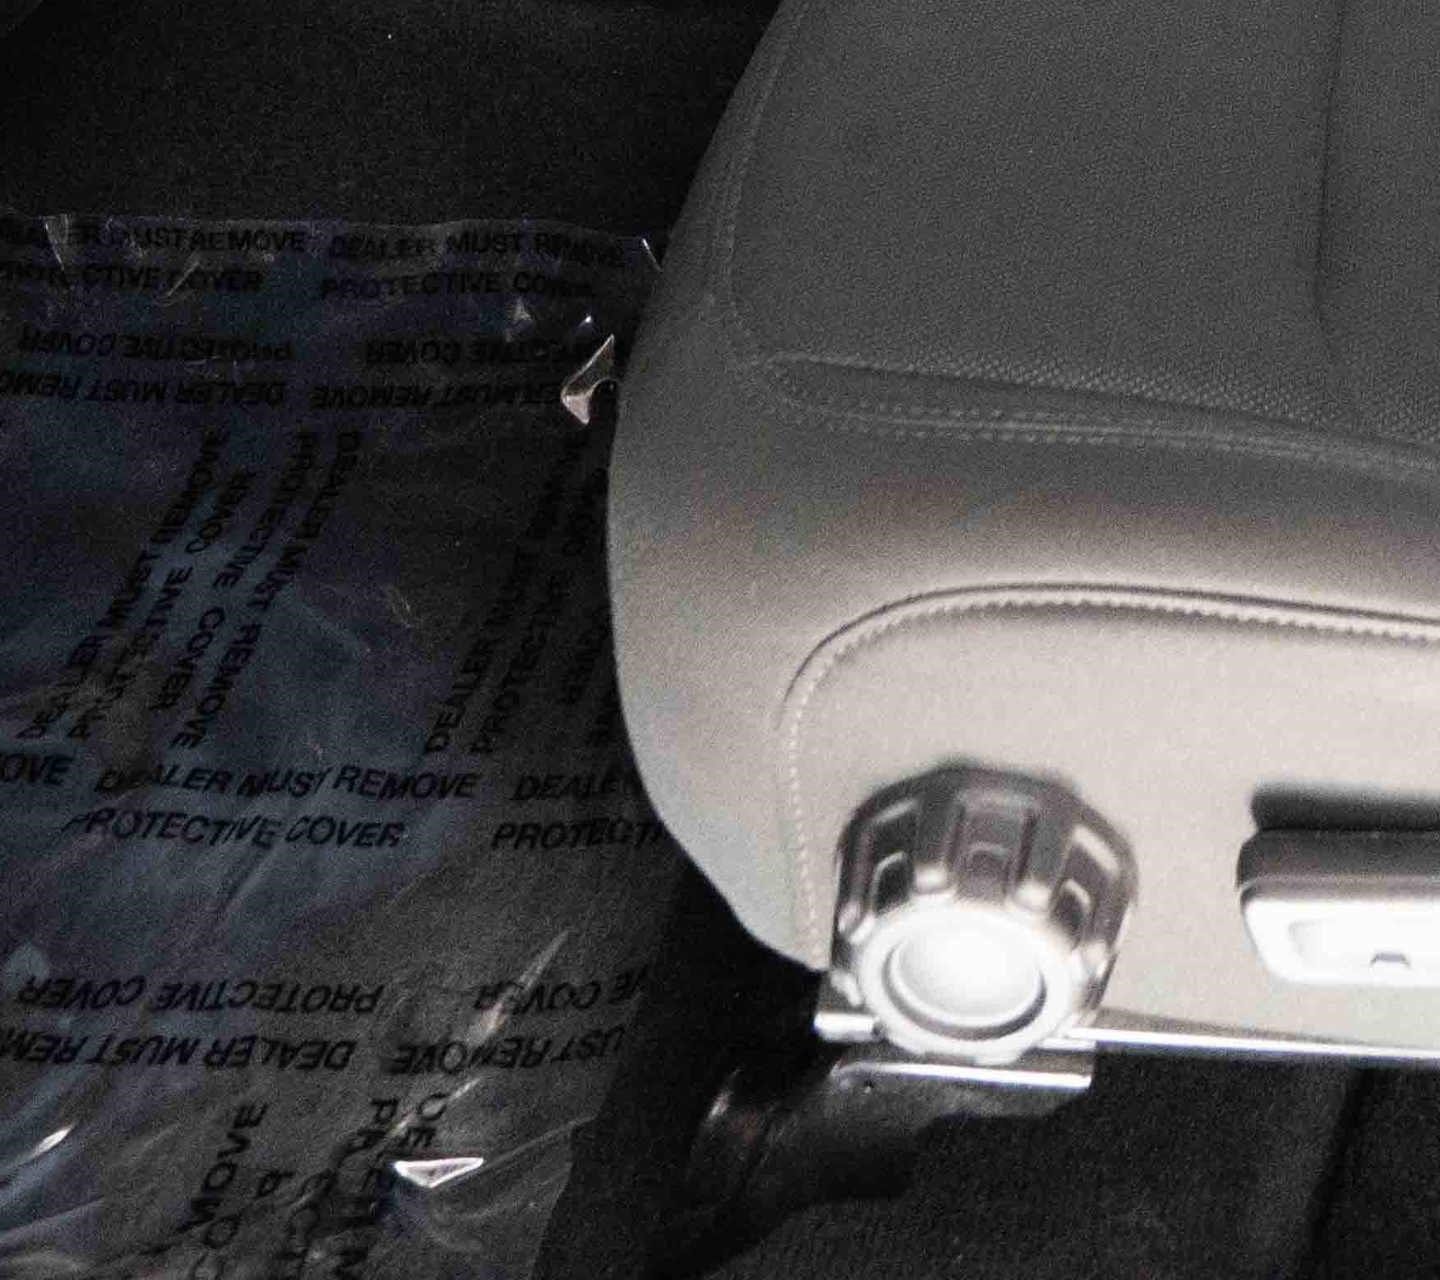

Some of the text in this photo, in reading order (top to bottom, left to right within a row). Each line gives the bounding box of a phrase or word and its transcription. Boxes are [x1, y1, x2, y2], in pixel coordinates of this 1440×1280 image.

[94, 762, 482, 801] DEALER MUST REMOVE
[284, 816, 406, 849] COVER
[15, 973, 386, 1015] PROTECTIVE COVER
[84, 1034, 202, 1067] MUST
[202, 1033, 359, 1072] DEALER
